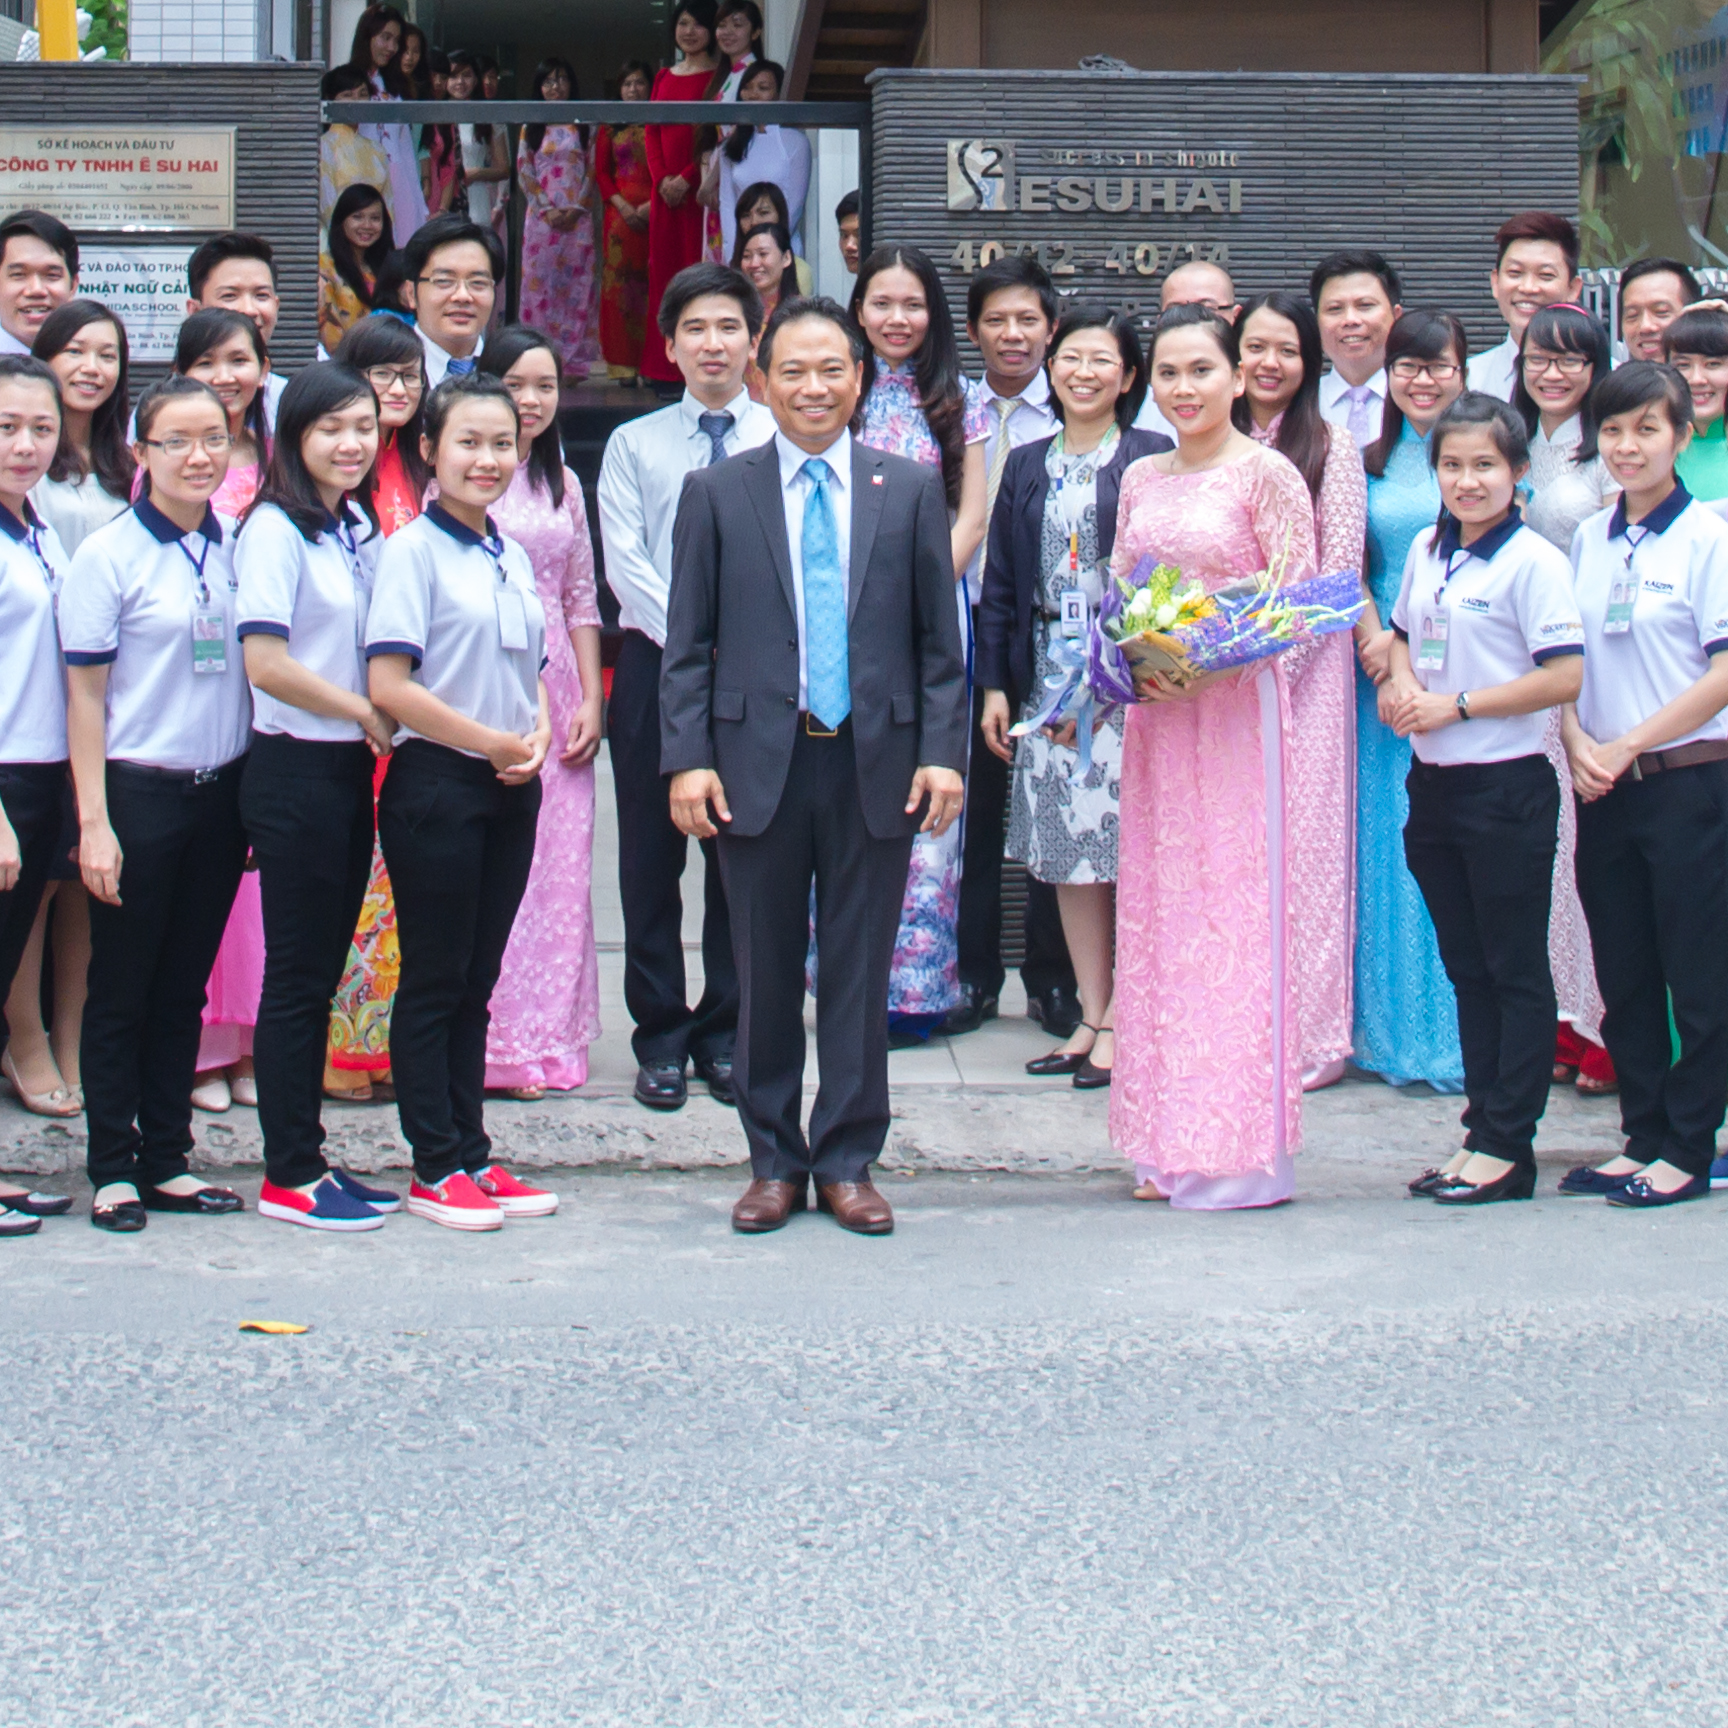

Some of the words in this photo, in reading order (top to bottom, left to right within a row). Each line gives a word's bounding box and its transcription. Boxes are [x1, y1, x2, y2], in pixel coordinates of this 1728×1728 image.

[114, 138, 130, 150] VÀ
[55, 159, 77, 172] TY
[83, 160, 133, 172] TNHH
[139, 156, 151, 172] Ê
[156, 159, 182, 172] SU
[188, 159, 218, 172] HAI
[1021, 176, 1242, 213] ESUHAI
[87, 261, 103, 273] VÀ
[78, 280, 120, 297] NHẬT
[124, 279, 160, 294] NGỮ
[132, 303, 181, 312] SCHOOL
